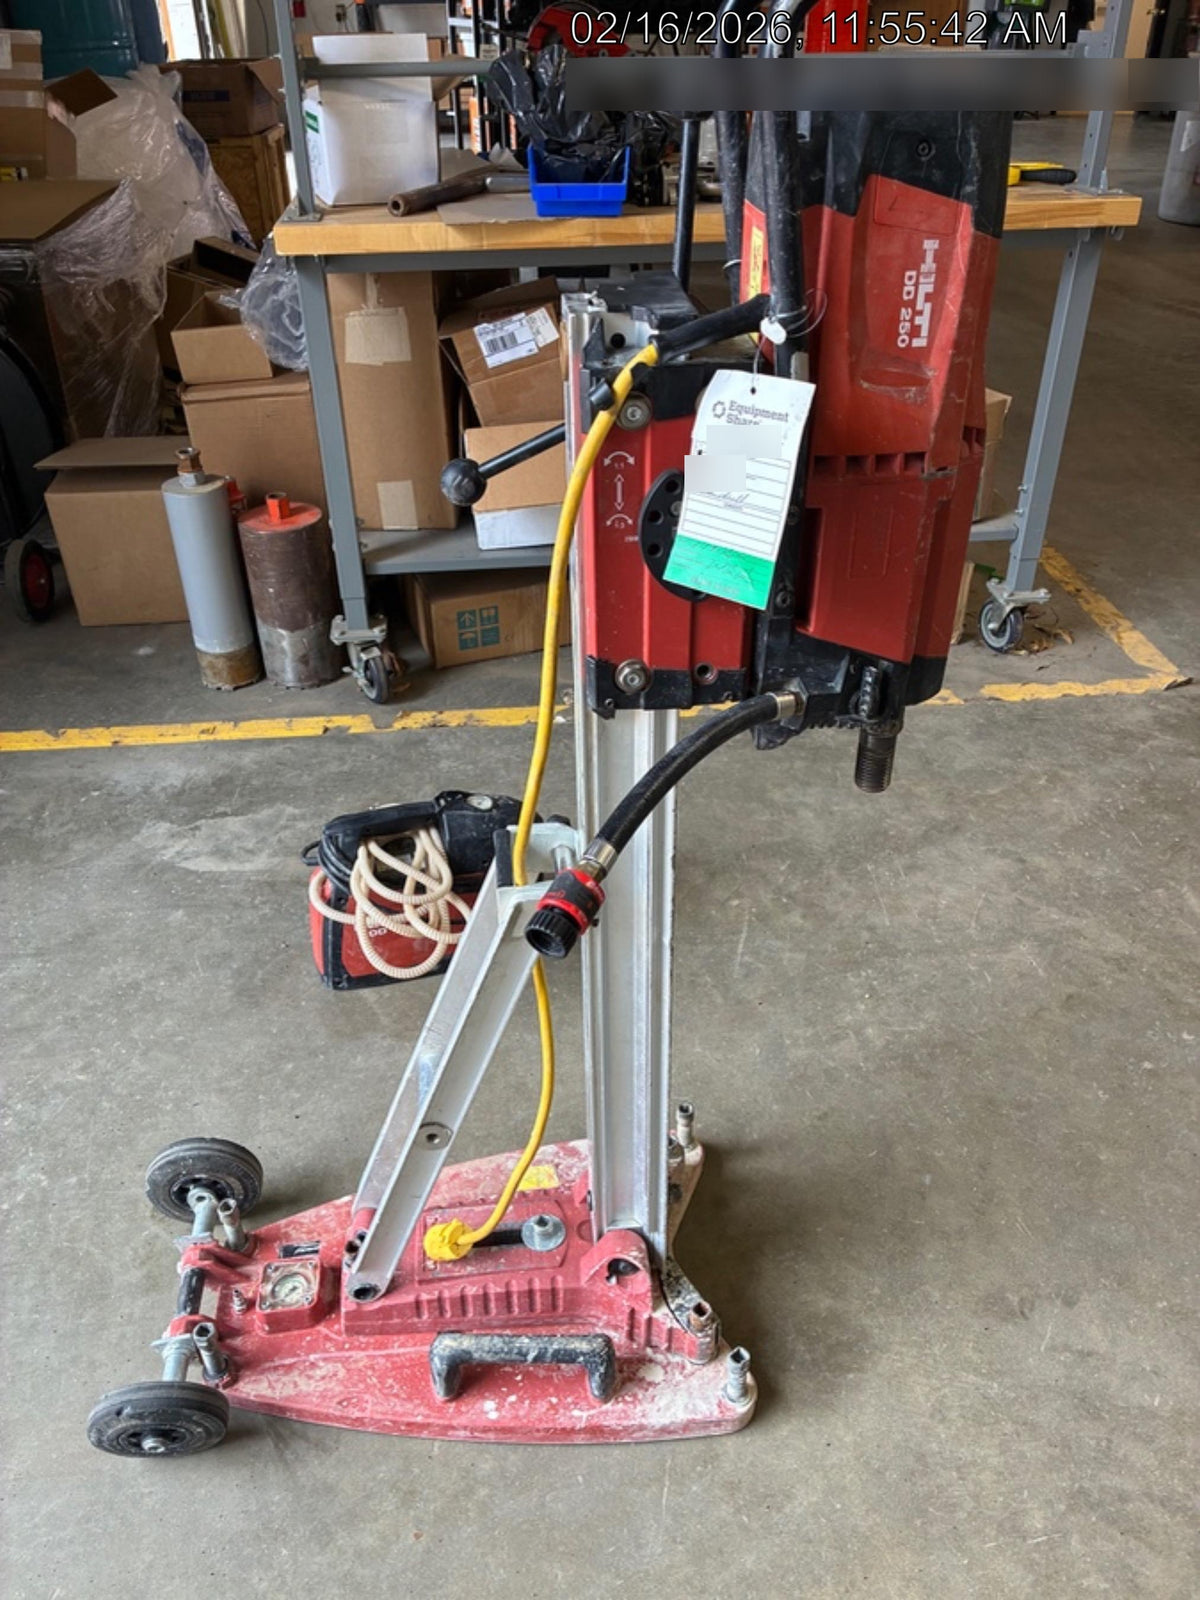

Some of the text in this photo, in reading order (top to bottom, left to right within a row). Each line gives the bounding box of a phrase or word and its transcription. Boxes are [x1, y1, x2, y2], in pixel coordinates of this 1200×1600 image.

[897, 270, 917, 347] DD 250
[911, 239, 940, 347] HILTI
[728, 400, 790, 422] Equipment
